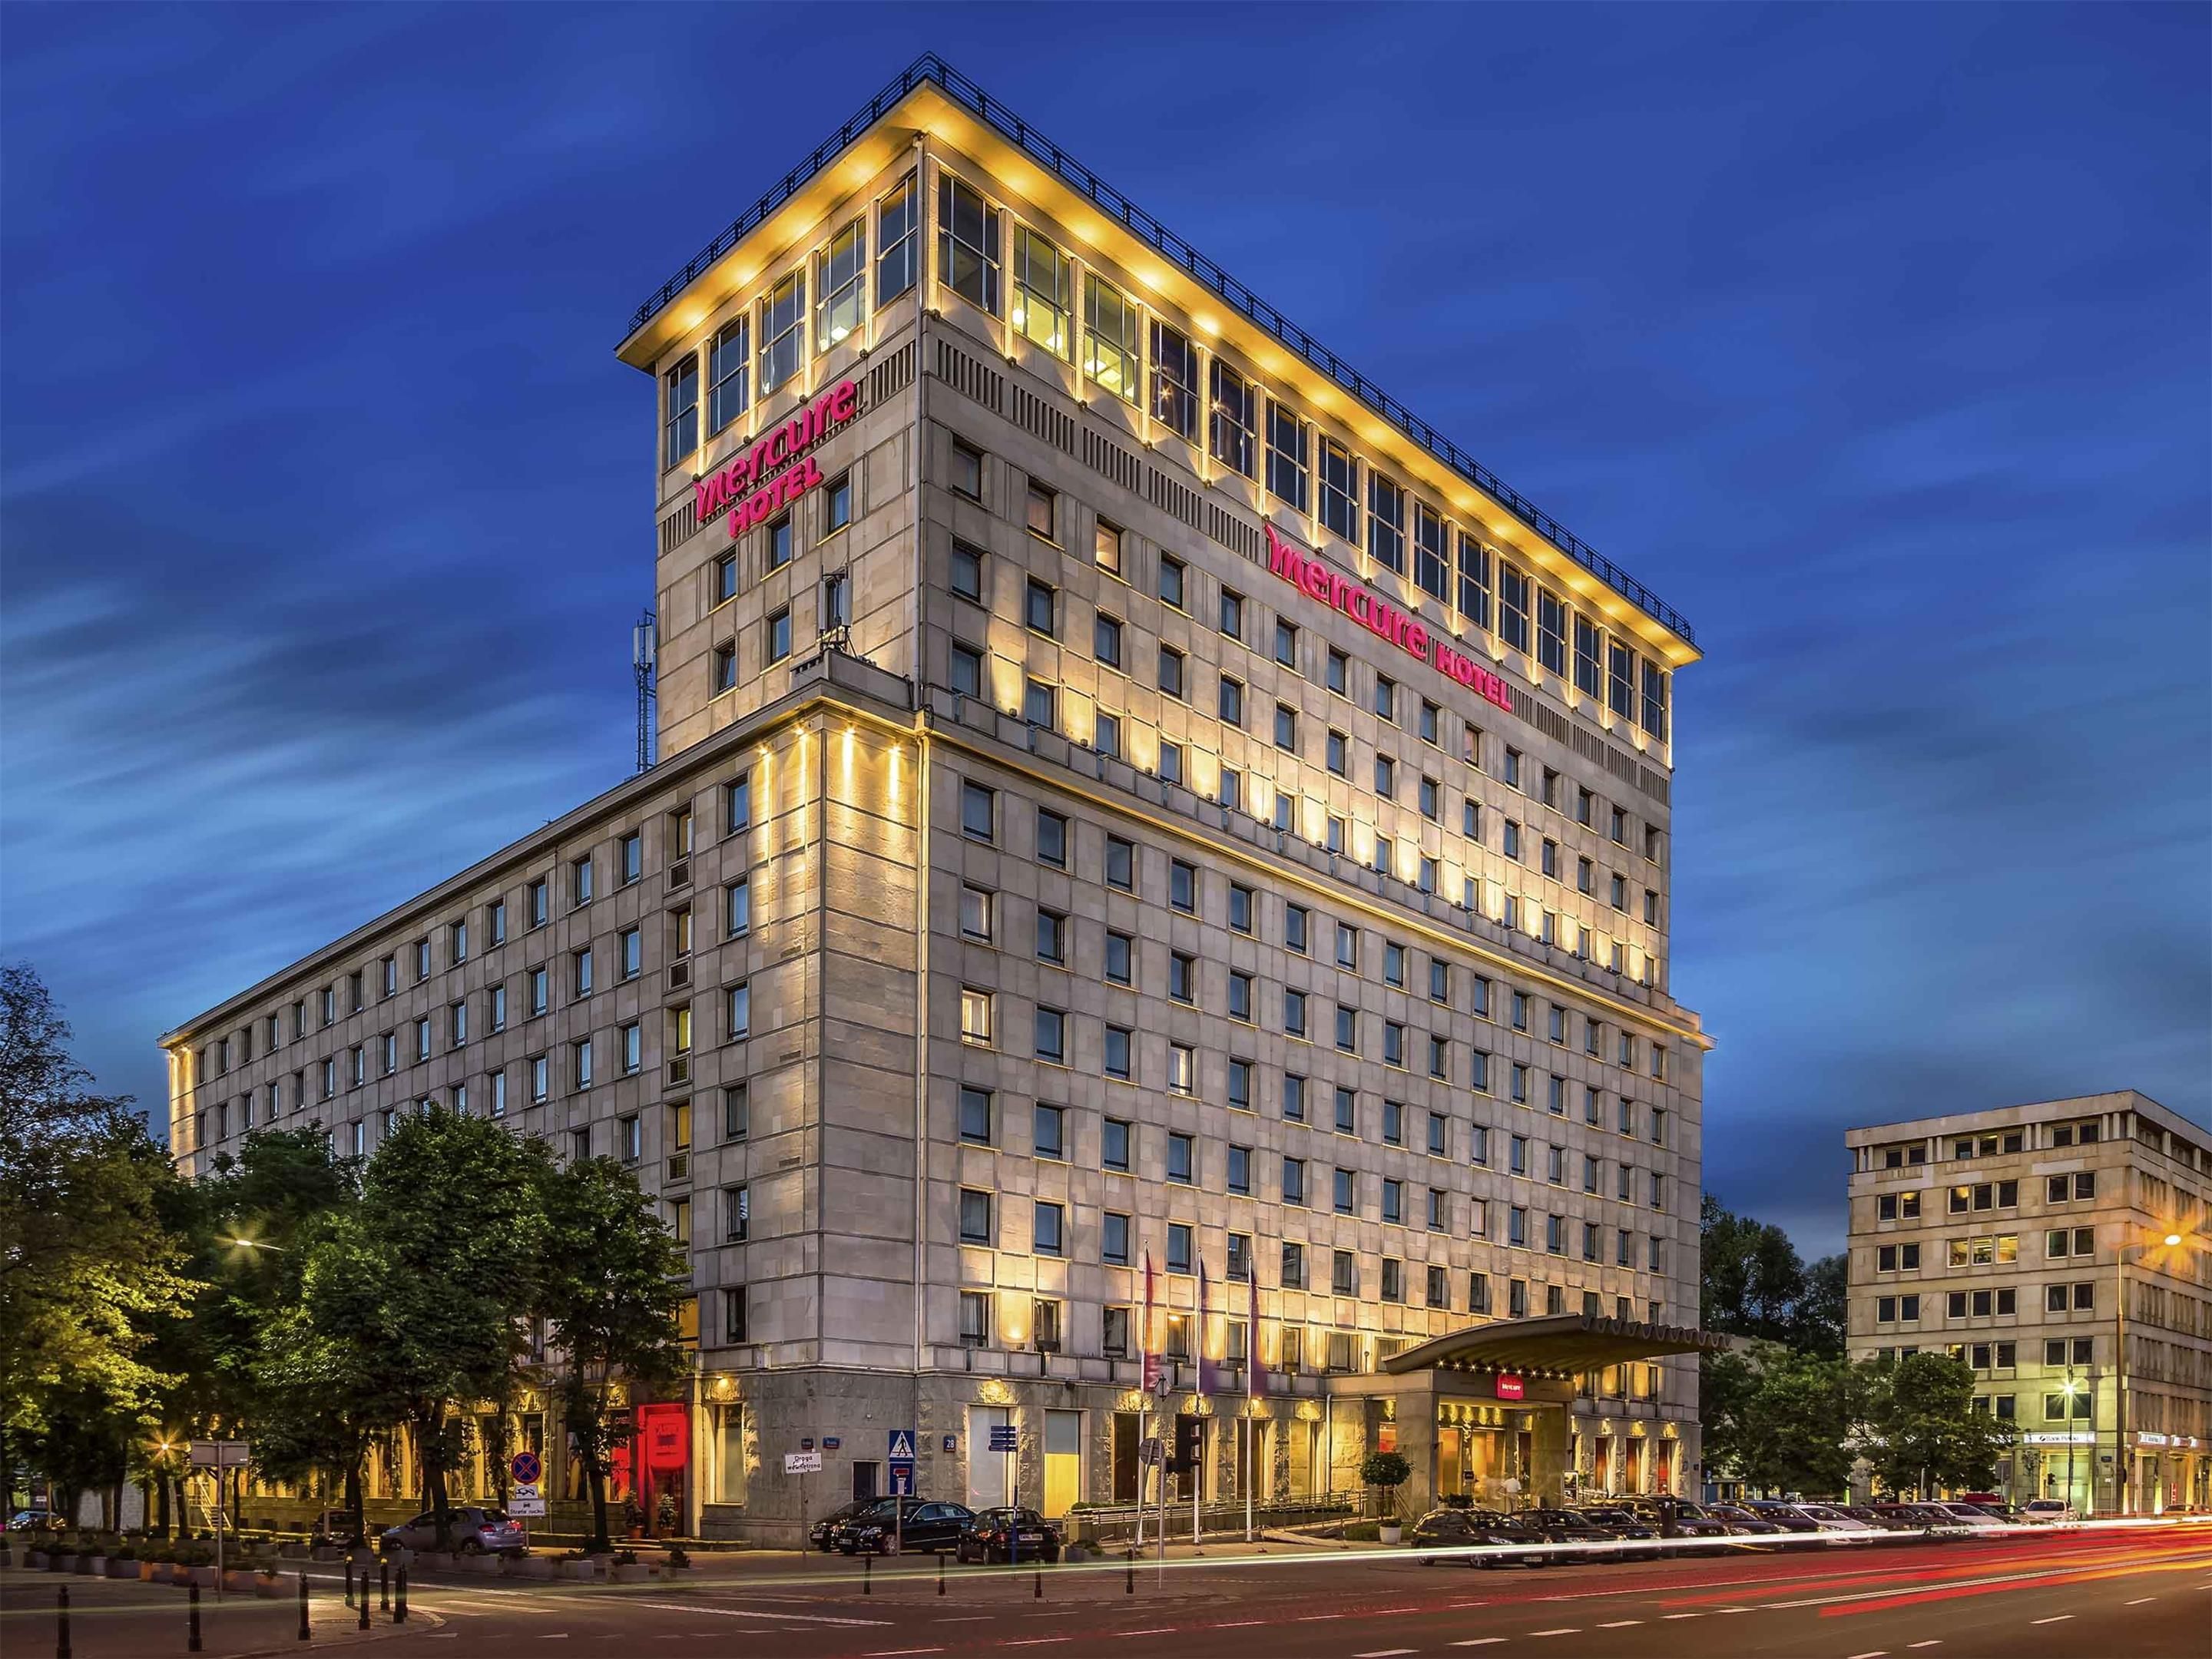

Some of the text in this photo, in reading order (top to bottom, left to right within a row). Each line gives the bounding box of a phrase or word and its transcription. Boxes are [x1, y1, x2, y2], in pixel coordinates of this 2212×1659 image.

[729, 457, 824, 538] HOTEL
[1435, 642, 1512, 713] HOTEL
[946, 1439, 955, 1448] 28
